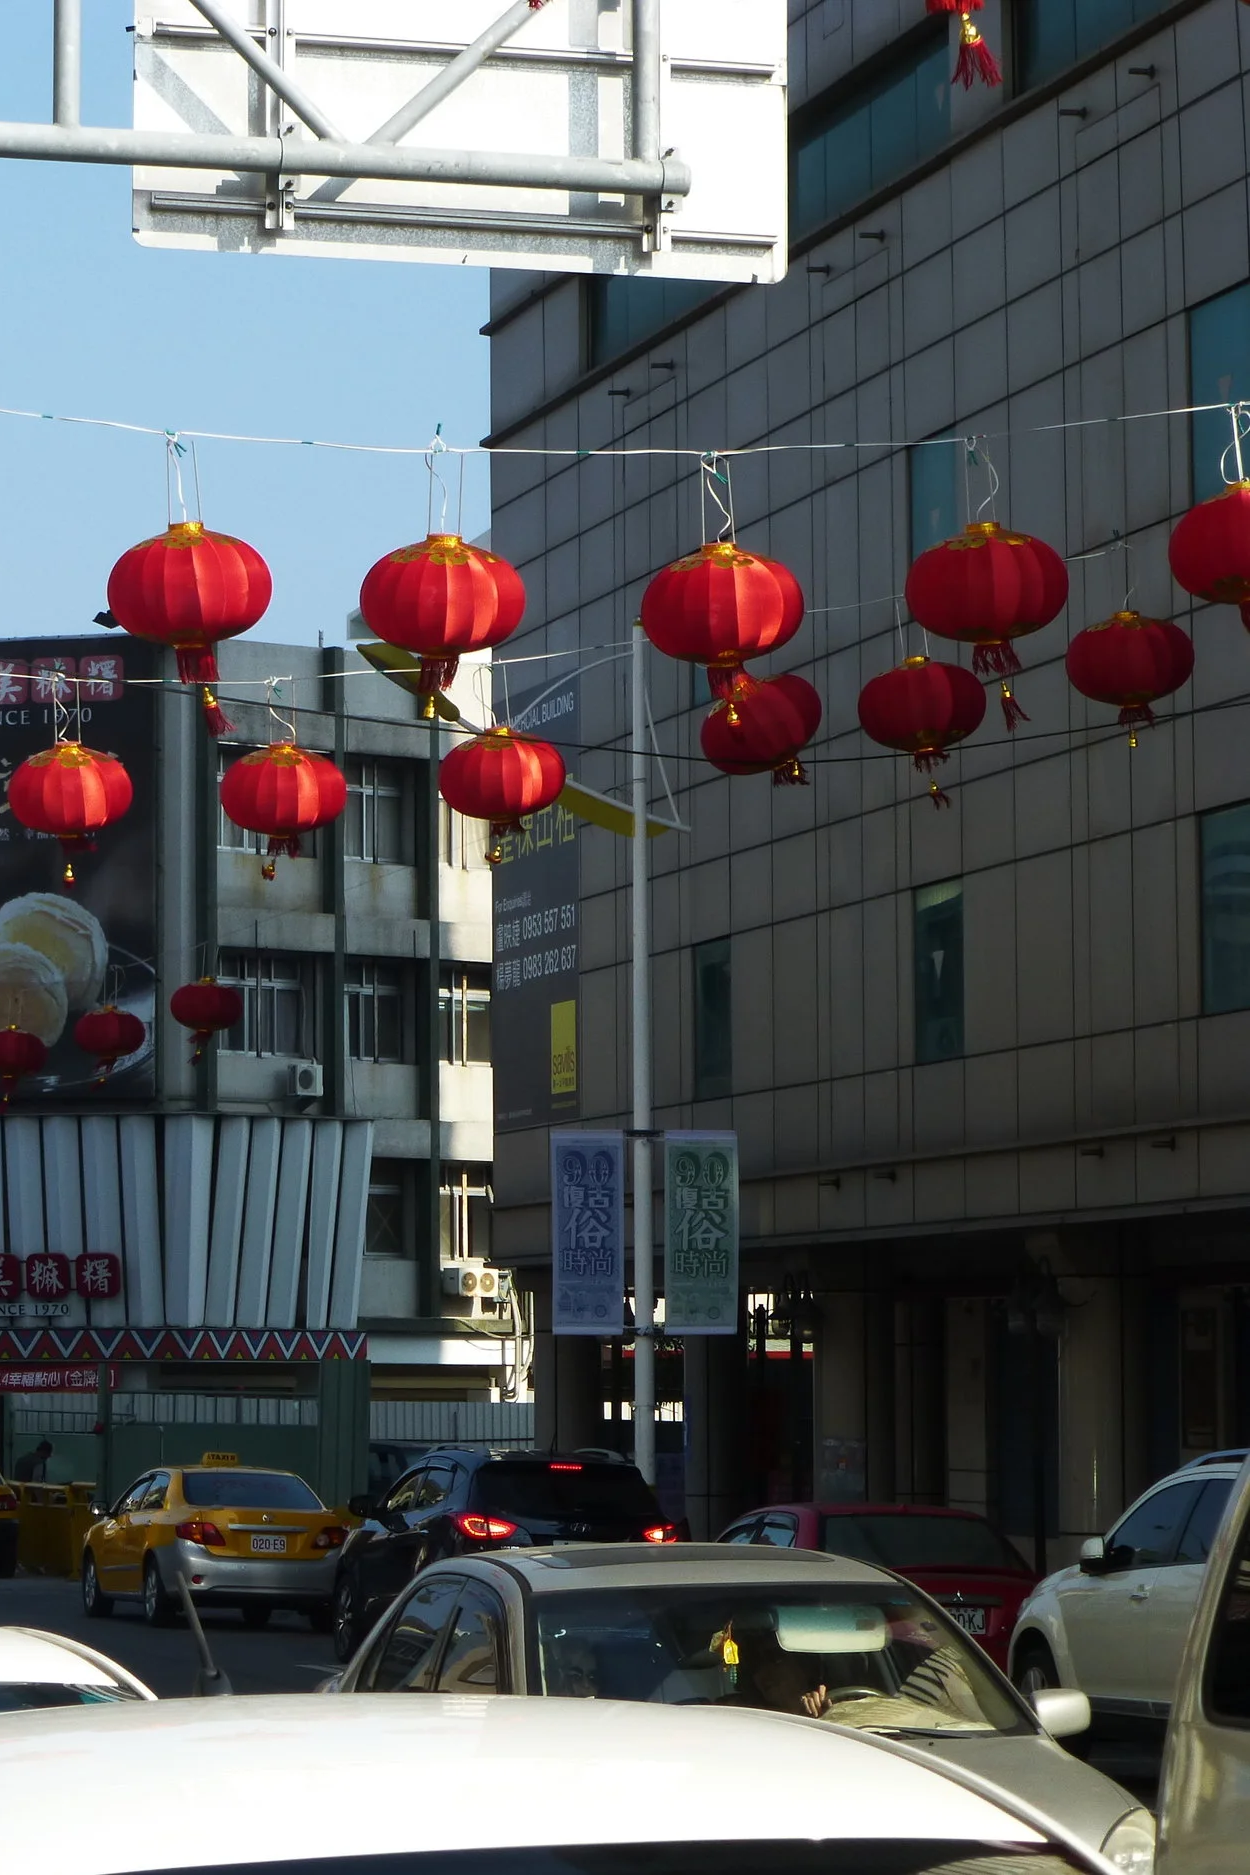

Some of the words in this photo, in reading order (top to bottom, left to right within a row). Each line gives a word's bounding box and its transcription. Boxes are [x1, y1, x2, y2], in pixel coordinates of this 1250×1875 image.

[43, 707, 93, 725] 1970
[522, 913, 543, 940] 0953
[544, 907, 559, 934] 557
[560, 904, 575, 929] 551
[561, 944, 577, 970] 637
[563, 1208, 613, 1250] 俗
[673, 1209, 729, 1251] 俗
[563, 1249, 613, 1277] 時尚
[674, 1250, 728, 1278] 時尚
[33, 1303, 70, 1316] 1970
